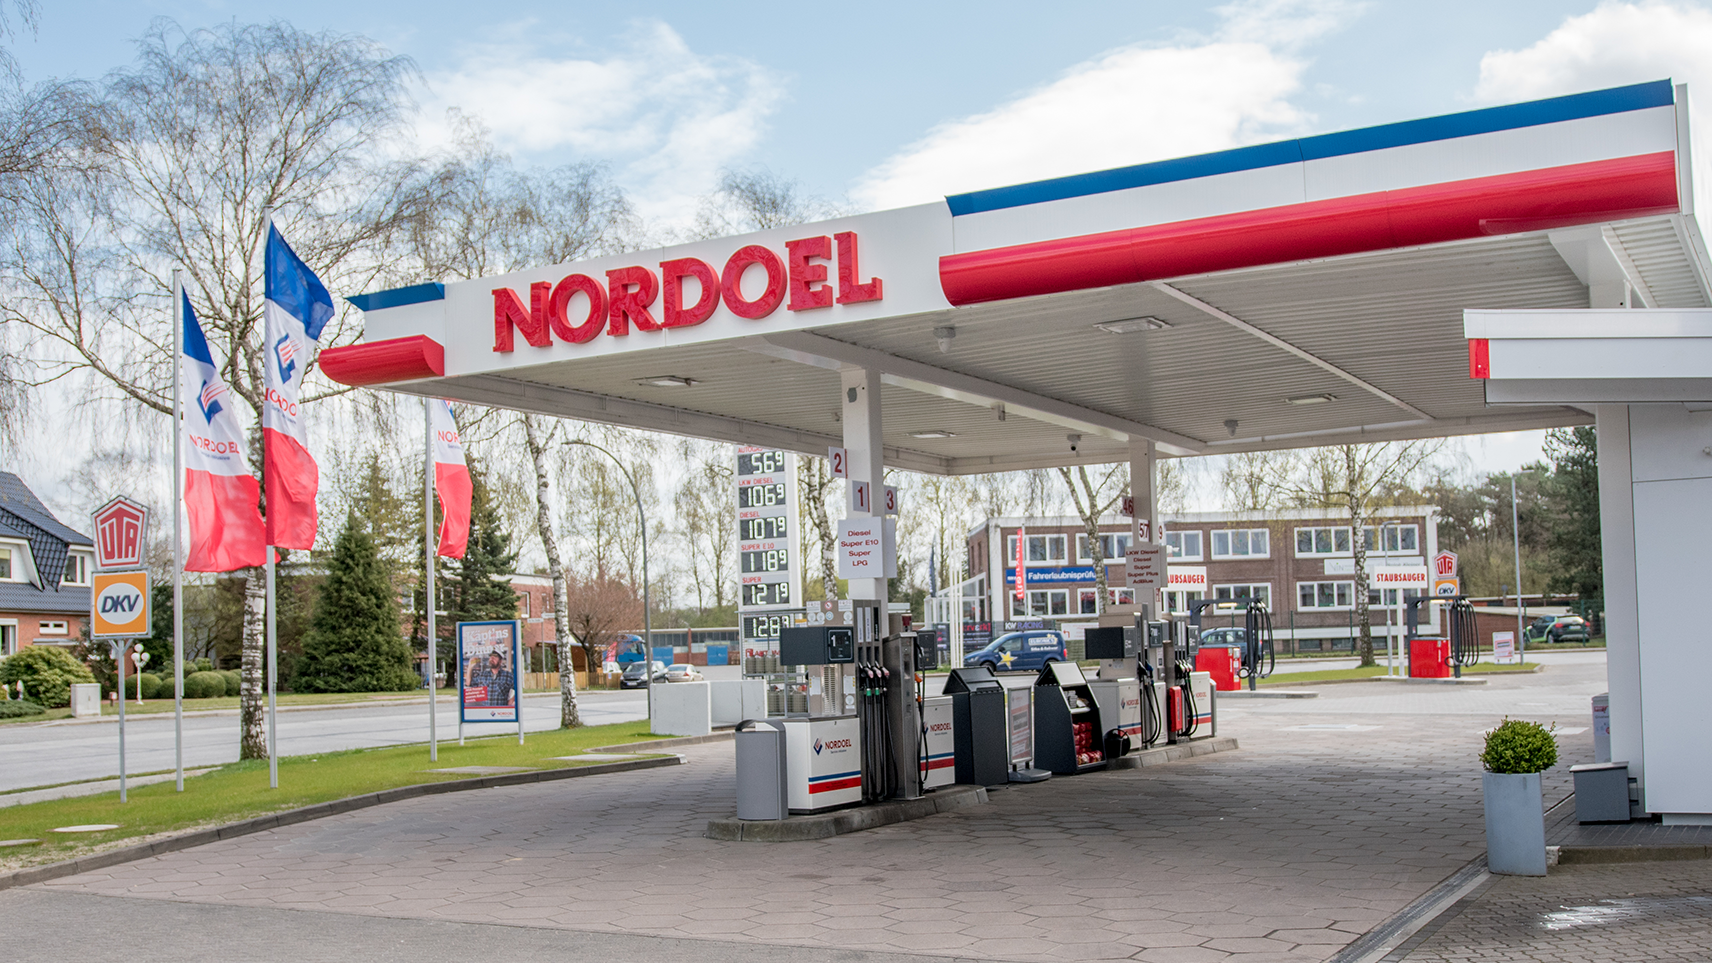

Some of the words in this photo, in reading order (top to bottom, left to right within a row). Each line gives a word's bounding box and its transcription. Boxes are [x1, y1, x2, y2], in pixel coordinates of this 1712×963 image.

[492, 231, 883, 353] NORDOEL
[751, 451, 784, 474] 569
[834, 452, 842, 473] 2
[753, 477, 774, 485] DIESEL
[748, 483, 785, 507] 1069
[857, 486, 864, 507] 1
[886, 489, 894, 510] 3
[740, 511, 760, 519] DIESEL
[100, 507, 140, 560] UTA
[749, 517, 786, 539] 1079
[847, 529, 871, 537] Diesel
[741, 543, 760, 551] SUPER
[750, 549, 787, 572] 1189
[1437, 555, 1453, 574] UTA
[1028, 570, 1096, 580] Fahrerlaubnisprüfu
[1376, 573, 1426, 582] STAUBSAUGER
[751, 582, 789, 605] 1219
[1438, 587, 1455, 595] DKV
[101, 594, 140, 613] DKV
[1005, 622, 1017, 630] KW
[1017, 621, 1043, 629] RACING
[831, 635, 836, 647] 1
[930, 723, 951, 732] NORDOEL
[825, 739, 852, 750] NORDOEL
